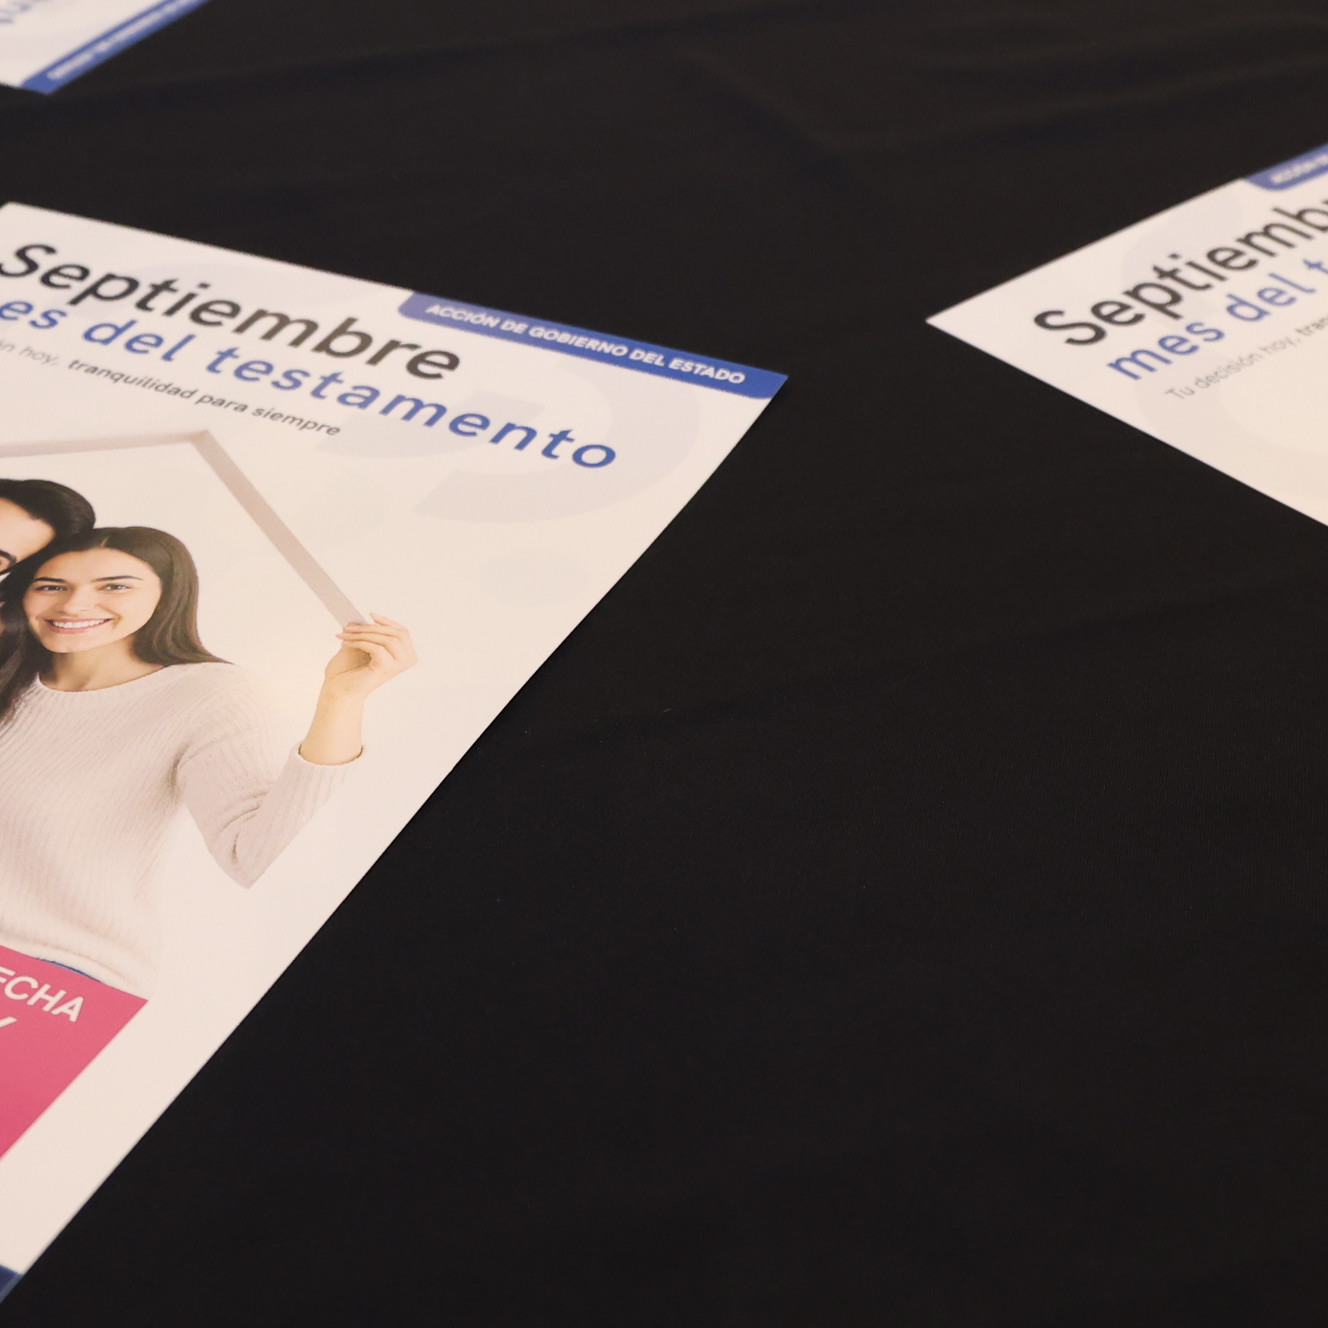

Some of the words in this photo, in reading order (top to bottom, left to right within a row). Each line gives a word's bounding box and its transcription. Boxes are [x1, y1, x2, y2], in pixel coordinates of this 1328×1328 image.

[425, 302, 499, 330] ACCIÓN
[503, 318, 529, 335] DE
[529, 324, 629, 357] GOBIERNO
[629, 346, 667, 366] DEL
[667, 356, 747, 385] ESTADO
[1107, 322, 1225, 380] mes
[1227, 273, 1317, 322] del
[1165, 383, 1195, 402] Tu
[1194, 352, 1262, 391] decisión
[1260, 336, 1301, 357] hoy,
[19, 344, 60, 368] hoy,
[68, 358, 197, 400] tranquilidad
[195, 389, 249, 416] para
[250, 405, 341, 438] siempre
[82, 318, 195, 363] del
[205, 345, 617, 469] testamento
